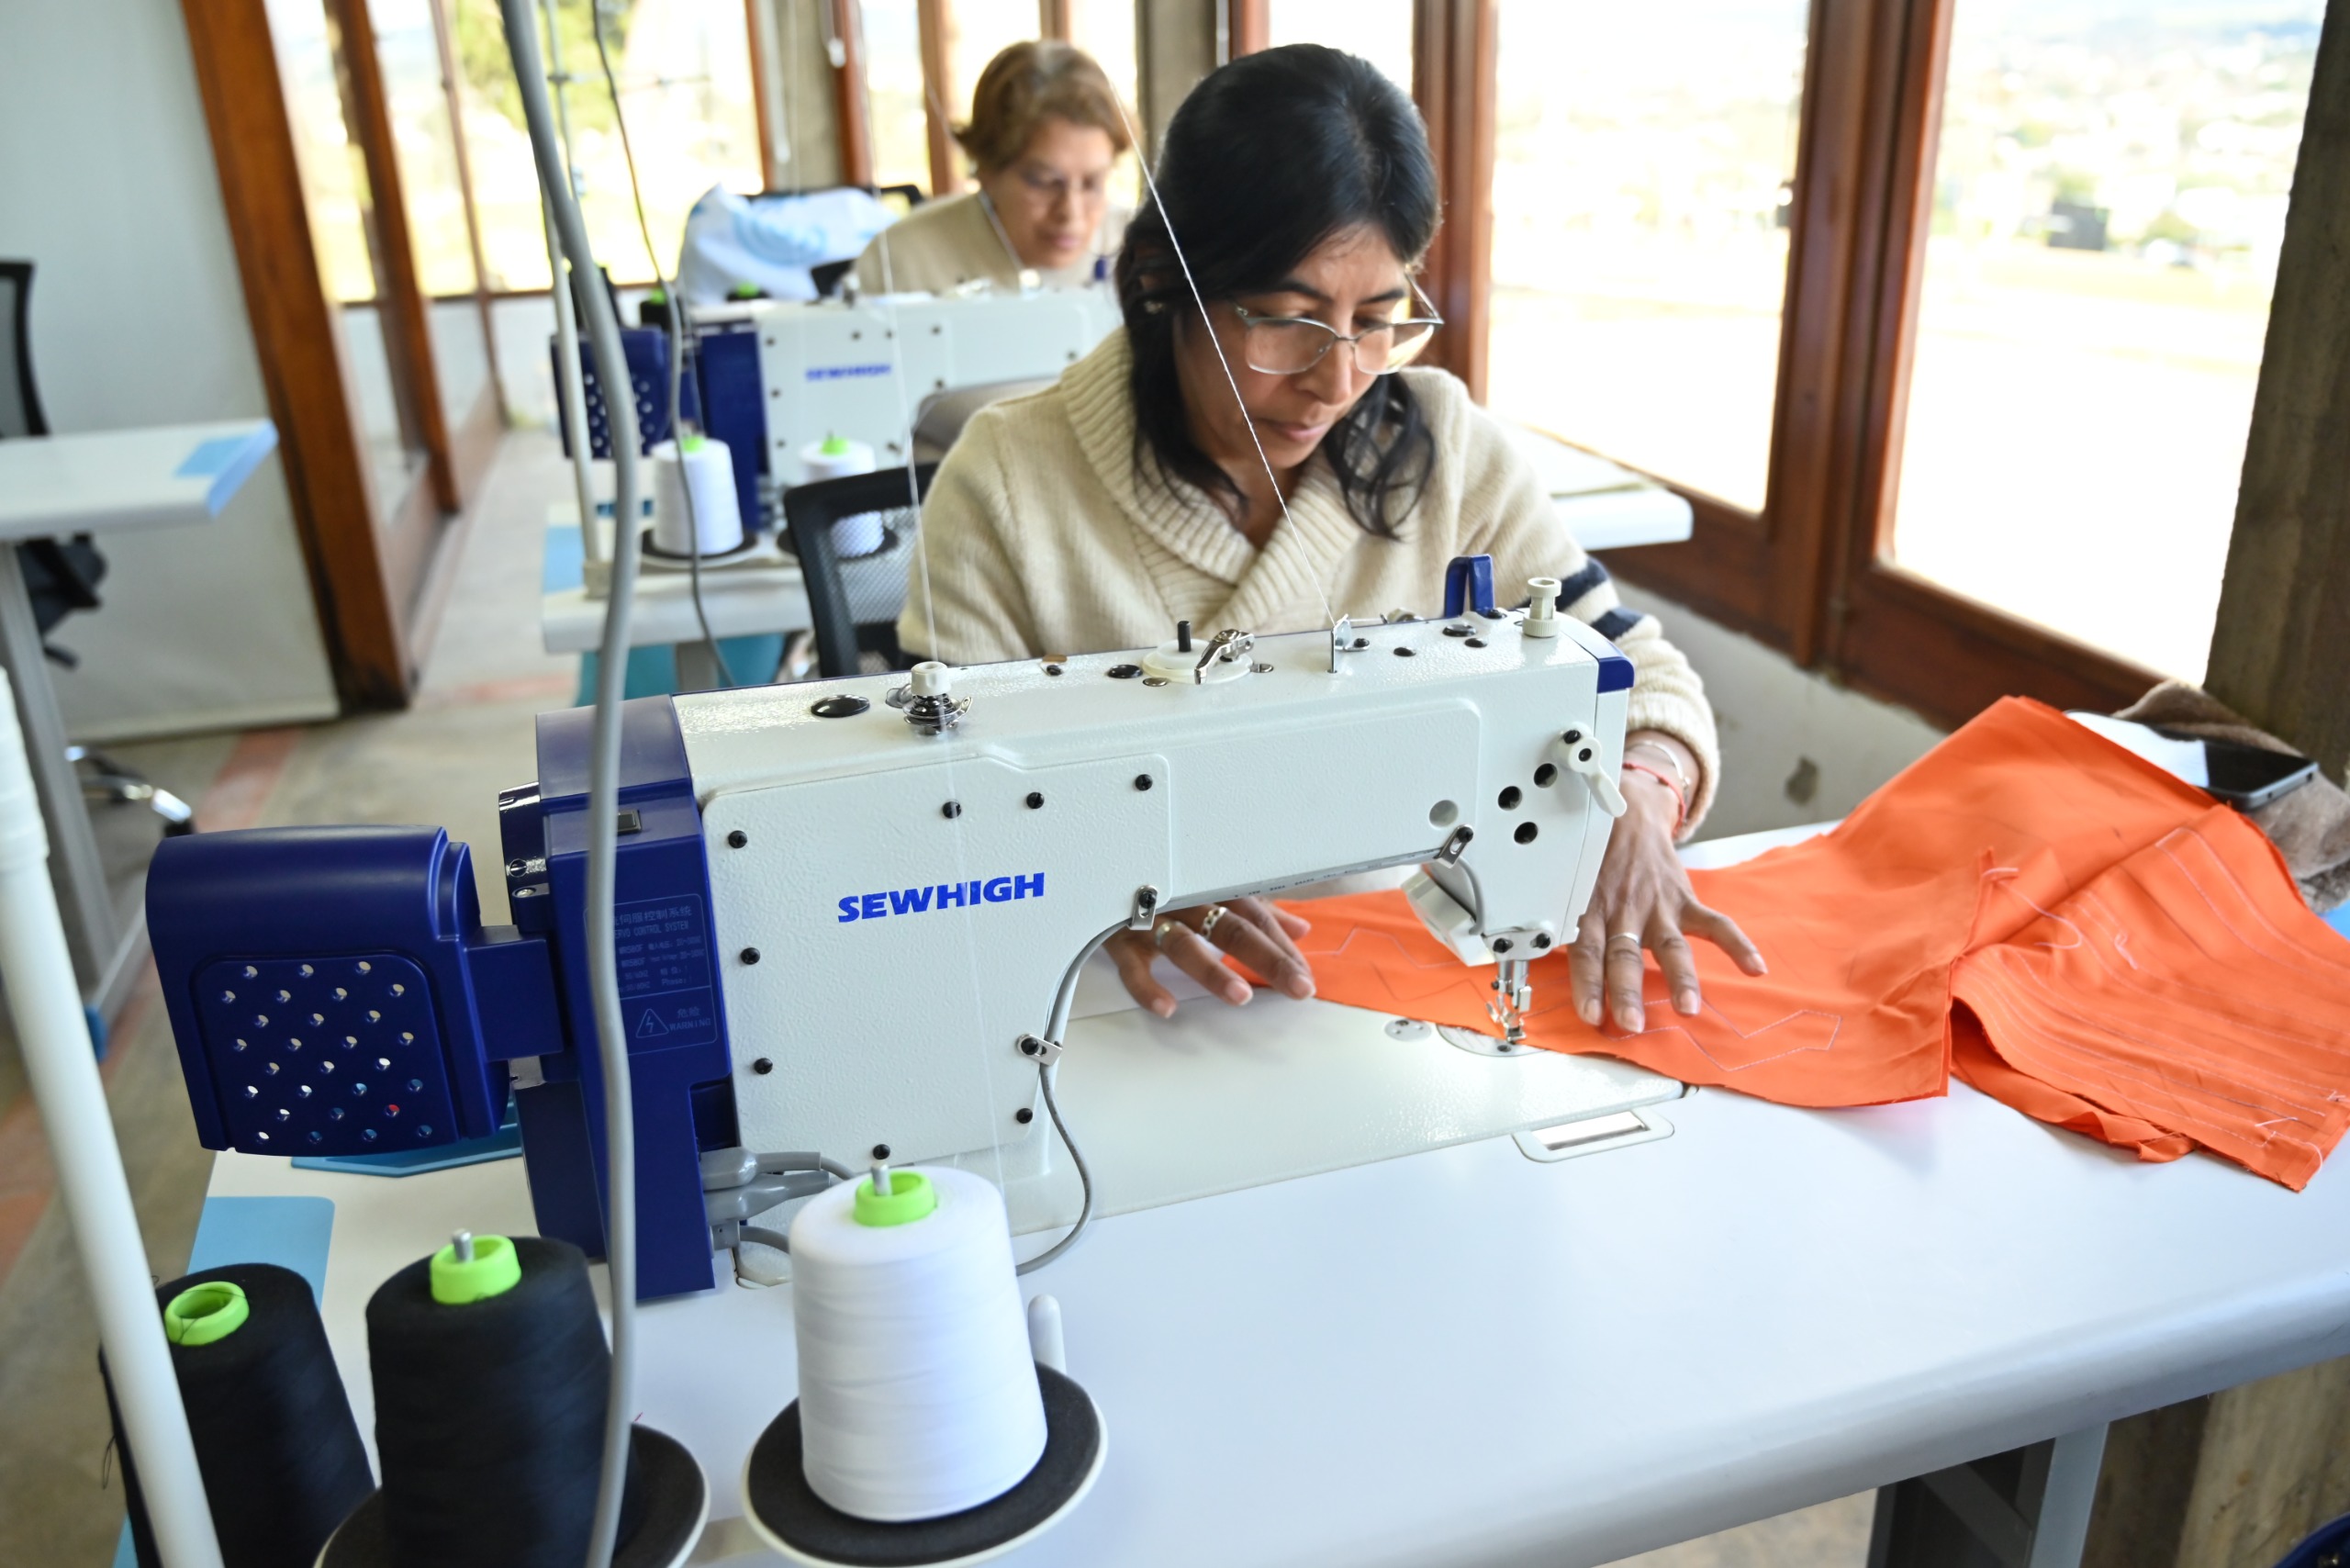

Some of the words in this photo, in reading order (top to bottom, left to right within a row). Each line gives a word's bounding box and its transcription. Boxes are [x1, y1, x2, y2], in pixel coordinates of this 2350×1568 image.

[837, 872, 1045, 923] SEWHIGH
[633, 924, 662, 936] CONTROL
[665, 920, 689, 933] SYSTEM
[669, 1017, 711, 1031] WARNING
